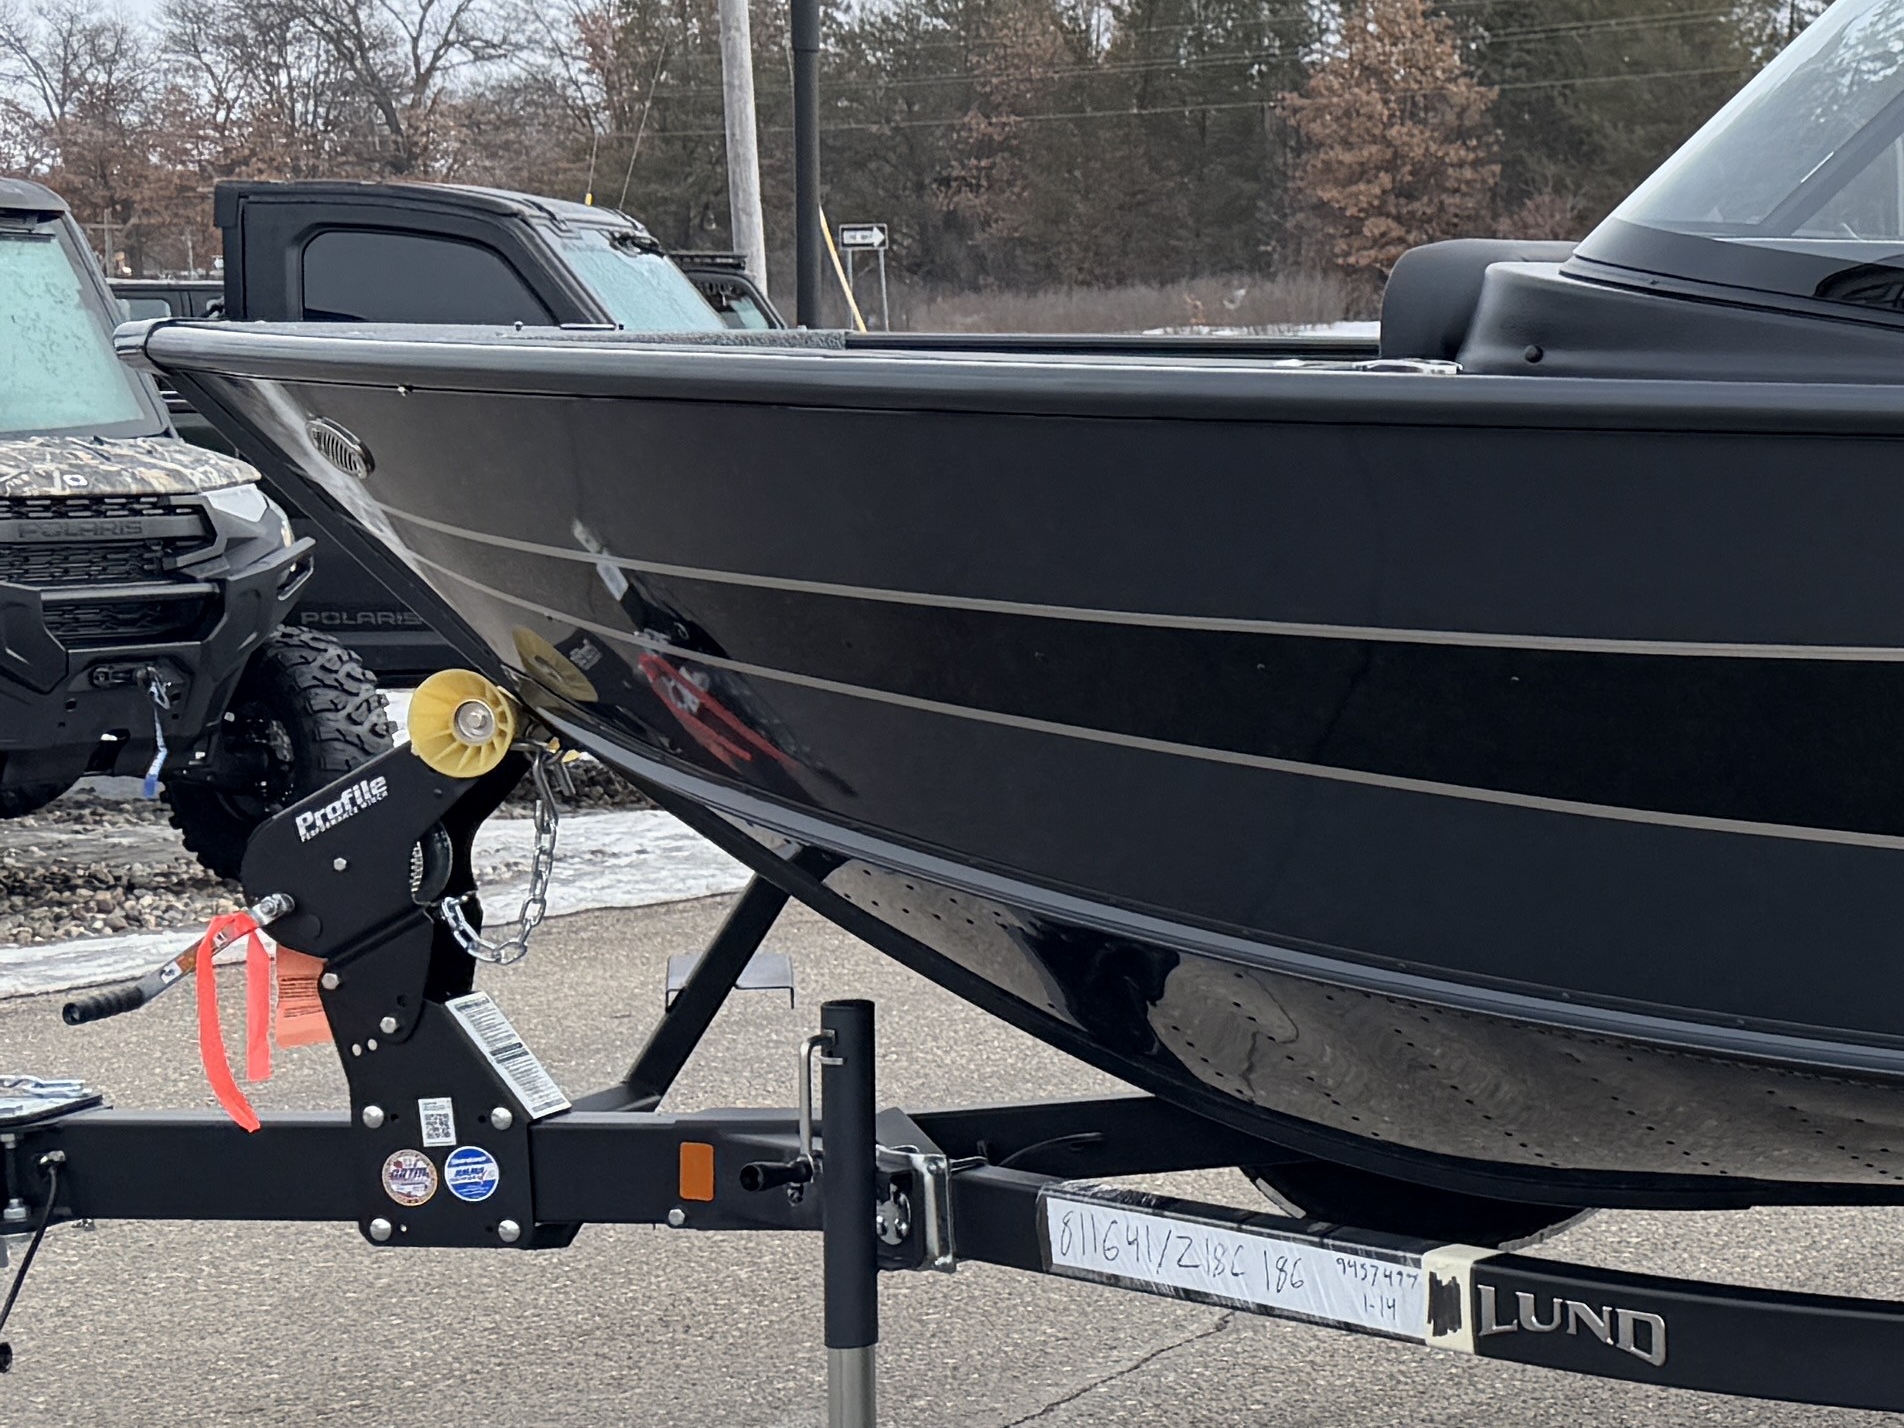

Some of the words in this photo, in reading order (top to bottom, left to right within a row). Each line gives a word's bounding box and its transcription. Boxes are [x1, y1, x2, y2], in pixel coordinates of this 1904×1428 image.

[18, 521, 143, 538] POLARIS
[301, 611, 423, 625] POLARIS
[295, 776, 387, 835] Profile
[1477, 1284, 1667, 1366] LUND
